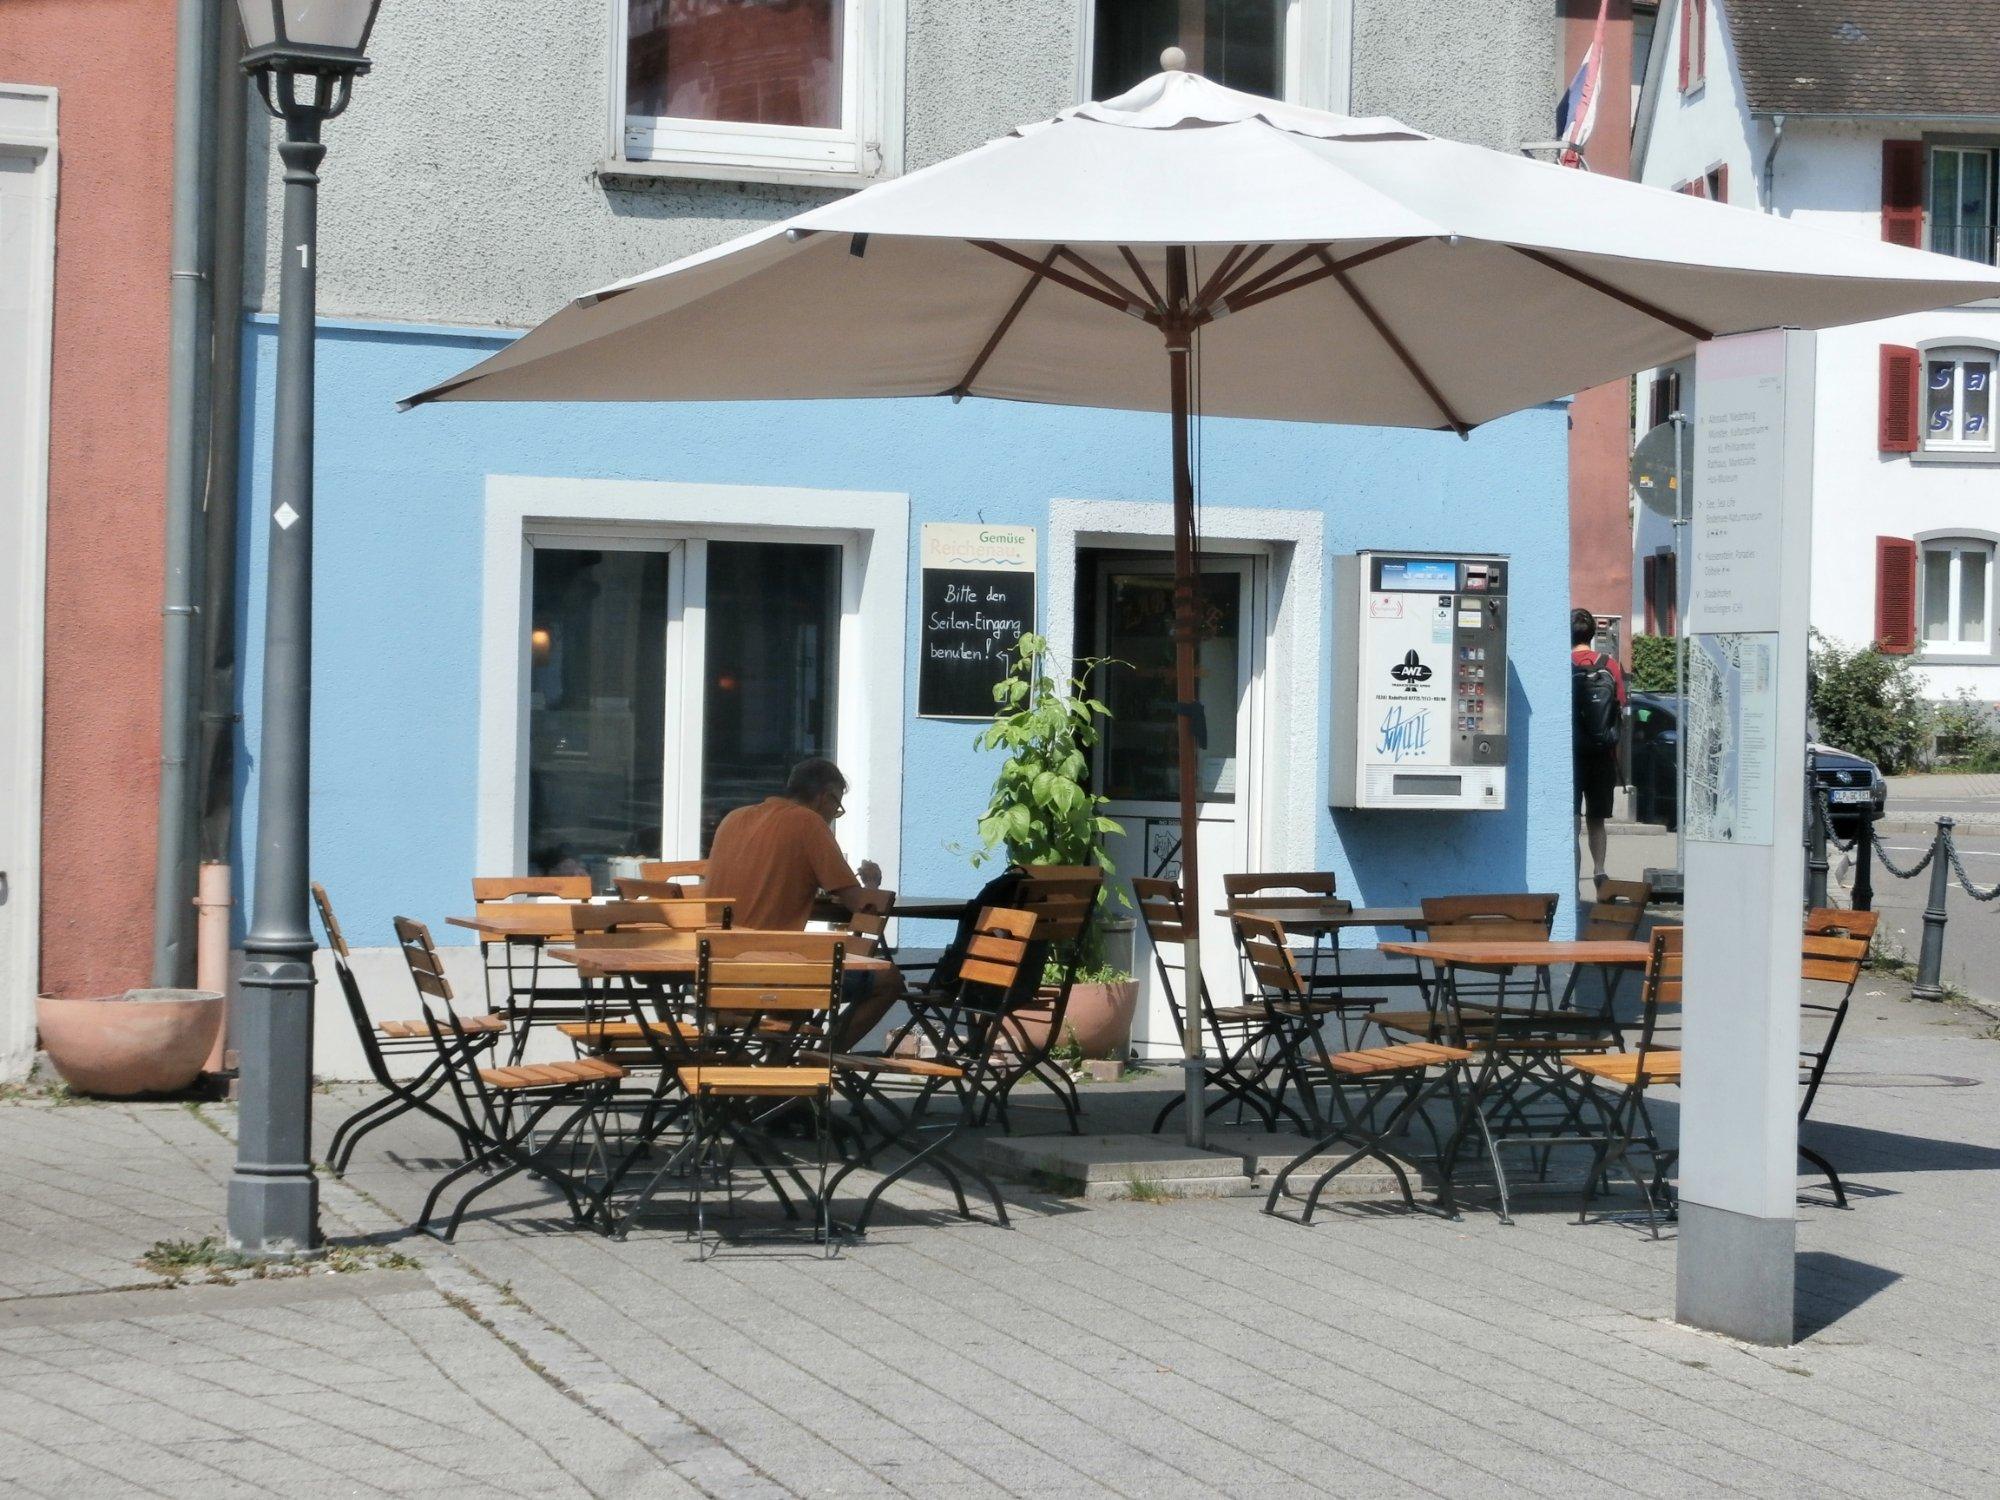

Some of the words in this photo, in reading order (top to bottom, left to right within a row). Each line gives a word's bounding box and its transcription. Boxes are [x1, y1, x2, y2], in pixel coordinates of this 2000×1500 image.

[296, 244, 308, 268] 1
[979, 531, 1025, 544] Gemüse
[944, 584, 977, 603] Bitte
[986, 585, 1006, 602] den
[928, 611, 1021, 639] Seiten-Eingang
